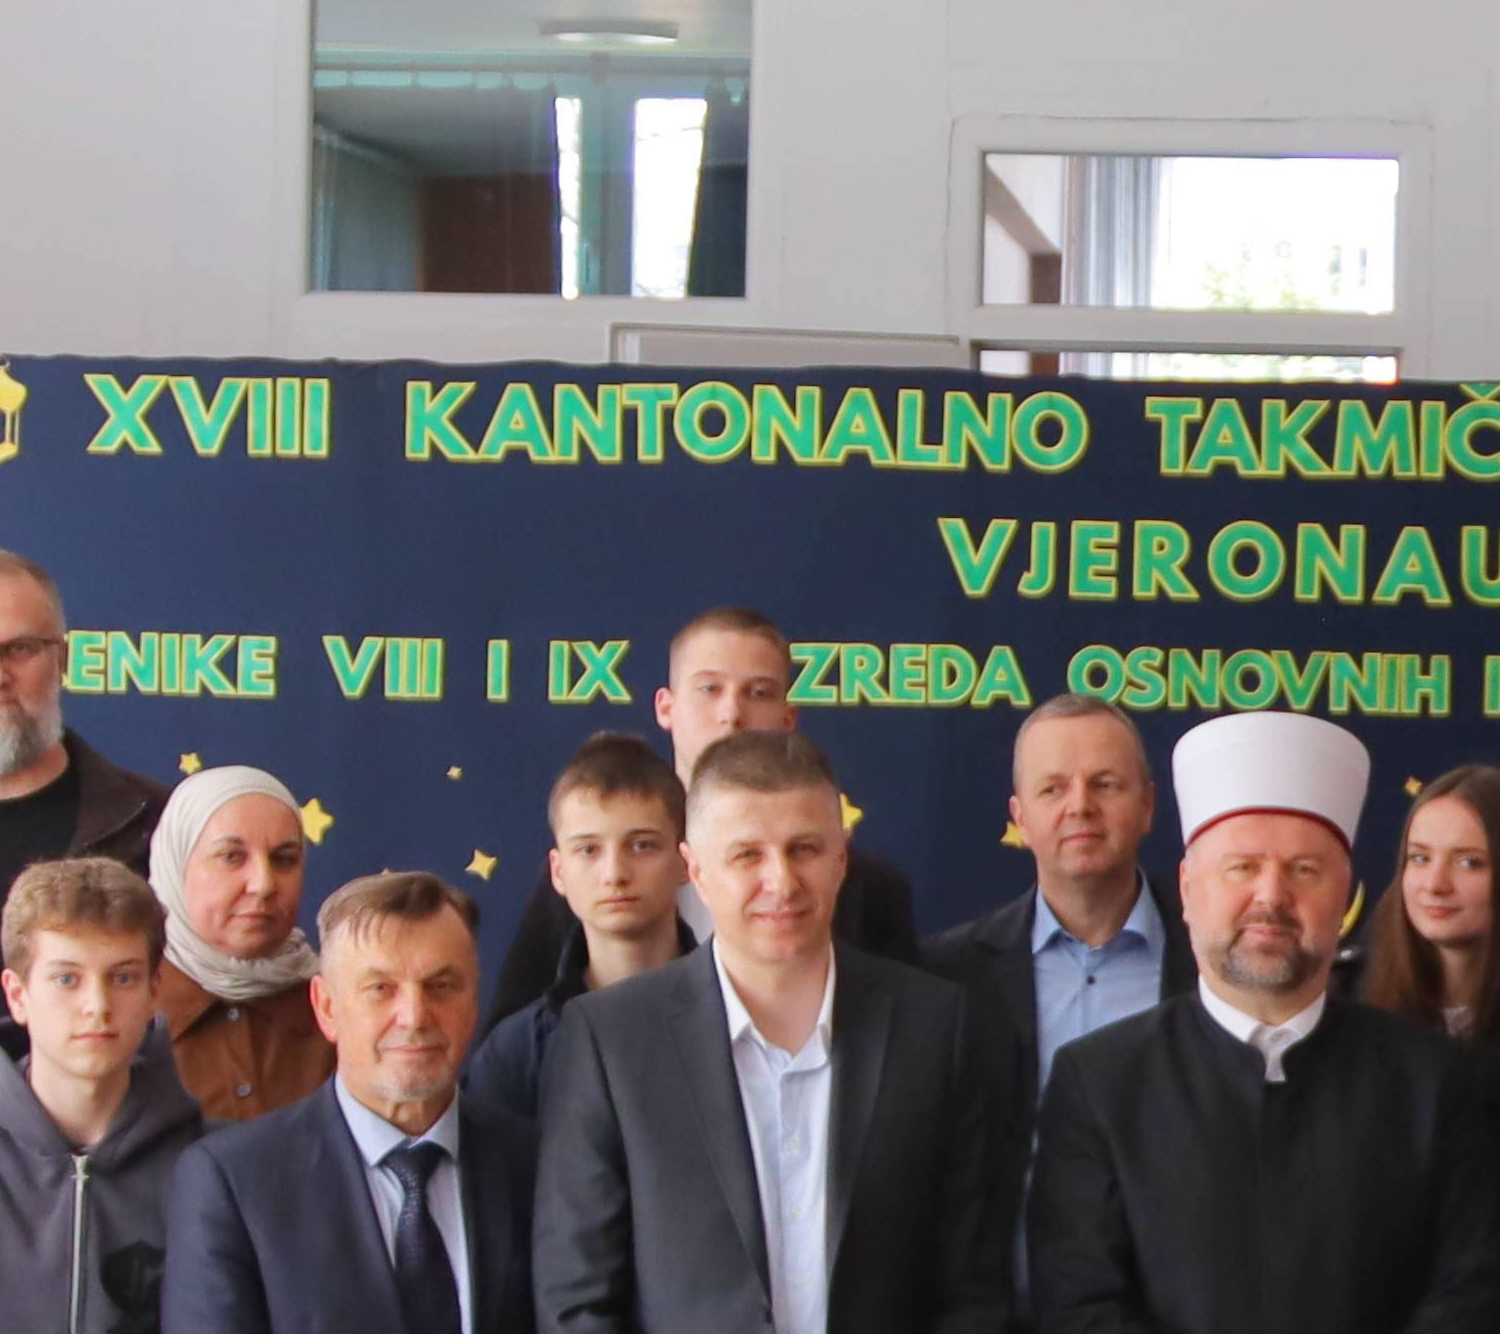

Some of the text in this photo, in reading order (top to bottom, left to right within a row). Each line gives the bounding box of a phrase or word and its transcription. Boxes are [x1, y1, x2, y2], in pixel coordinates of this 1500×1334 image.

[85, 373, 333, 459] XVIII
[406, 380, 1090, 475] KANTONALNO
[62, 630, 280, 698] ENIKE
[324, 634, 446, 700] VIII
[487, 638, 511, 704] I
[549, 639, 634, 706] IX
[786, 641, 1033, 709] ZREDA
[1069, 644, 1451, 717] OSNOVNIH
